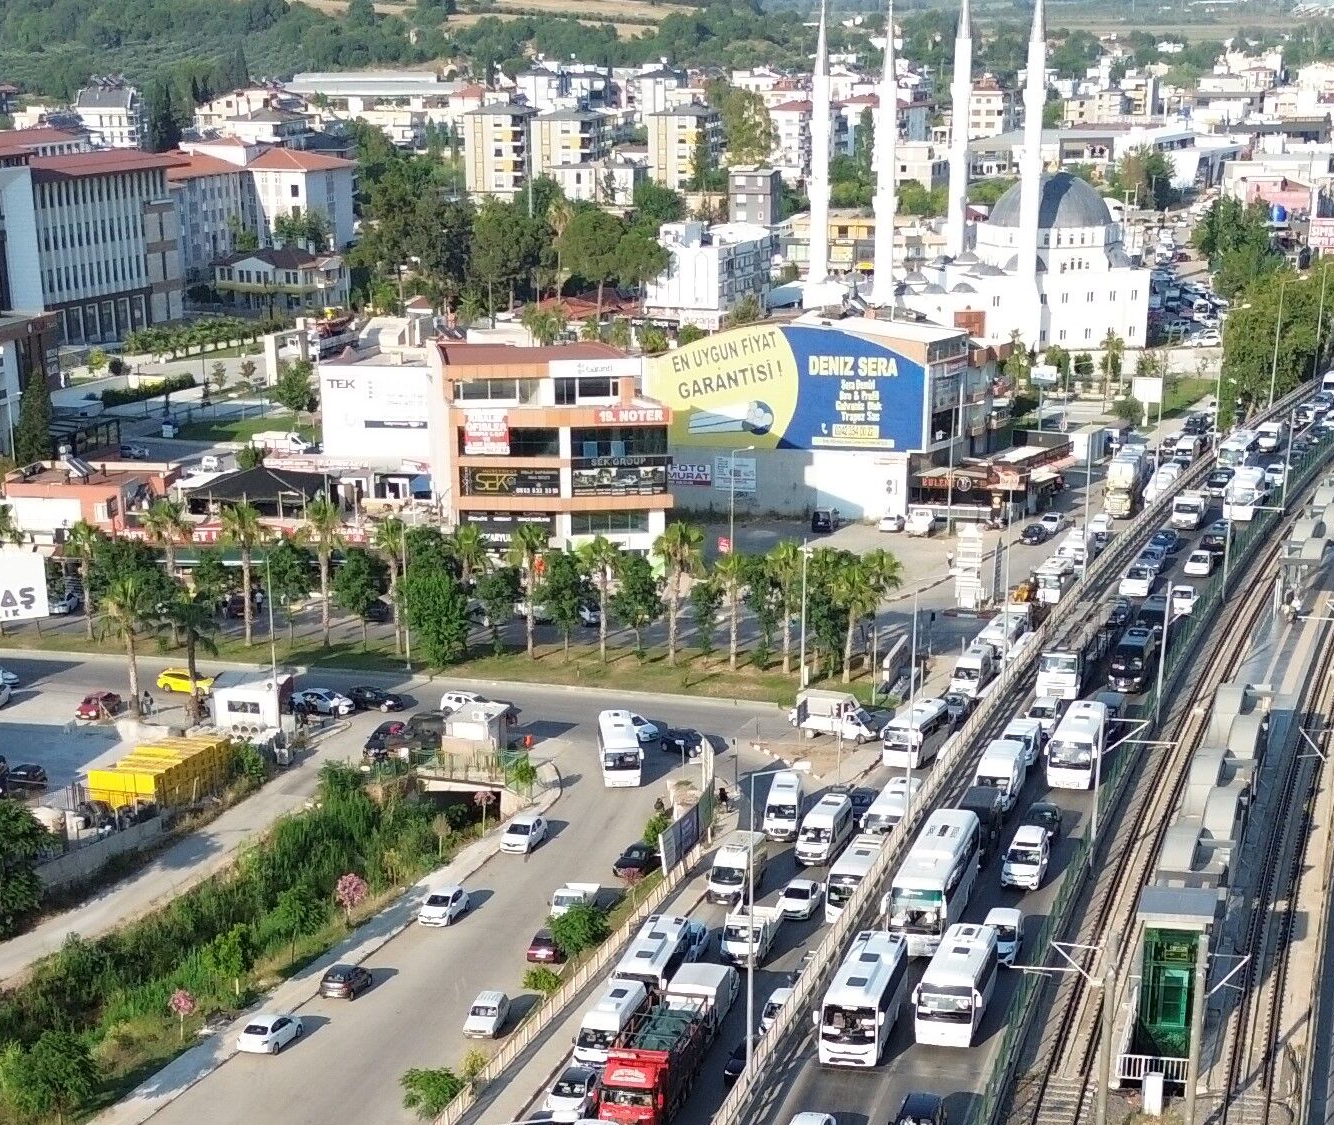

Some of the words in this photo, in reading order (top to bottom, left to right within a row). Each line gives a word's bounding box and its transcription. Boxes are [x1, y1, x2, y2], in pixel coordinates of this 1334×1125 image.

[672, 355, 691, 373] EN
[694, 341, 739, 371] UYGUN
[741, 330, 777, 358] FİYAT
[857, 356, 899, 377] SERA
[326, 378, 356, 389] TEK
[678, 361, 772, 399] GARANTİSİ
[599, 411, 616, 423] 19.
[619, 409, 664, 423] NOTER
